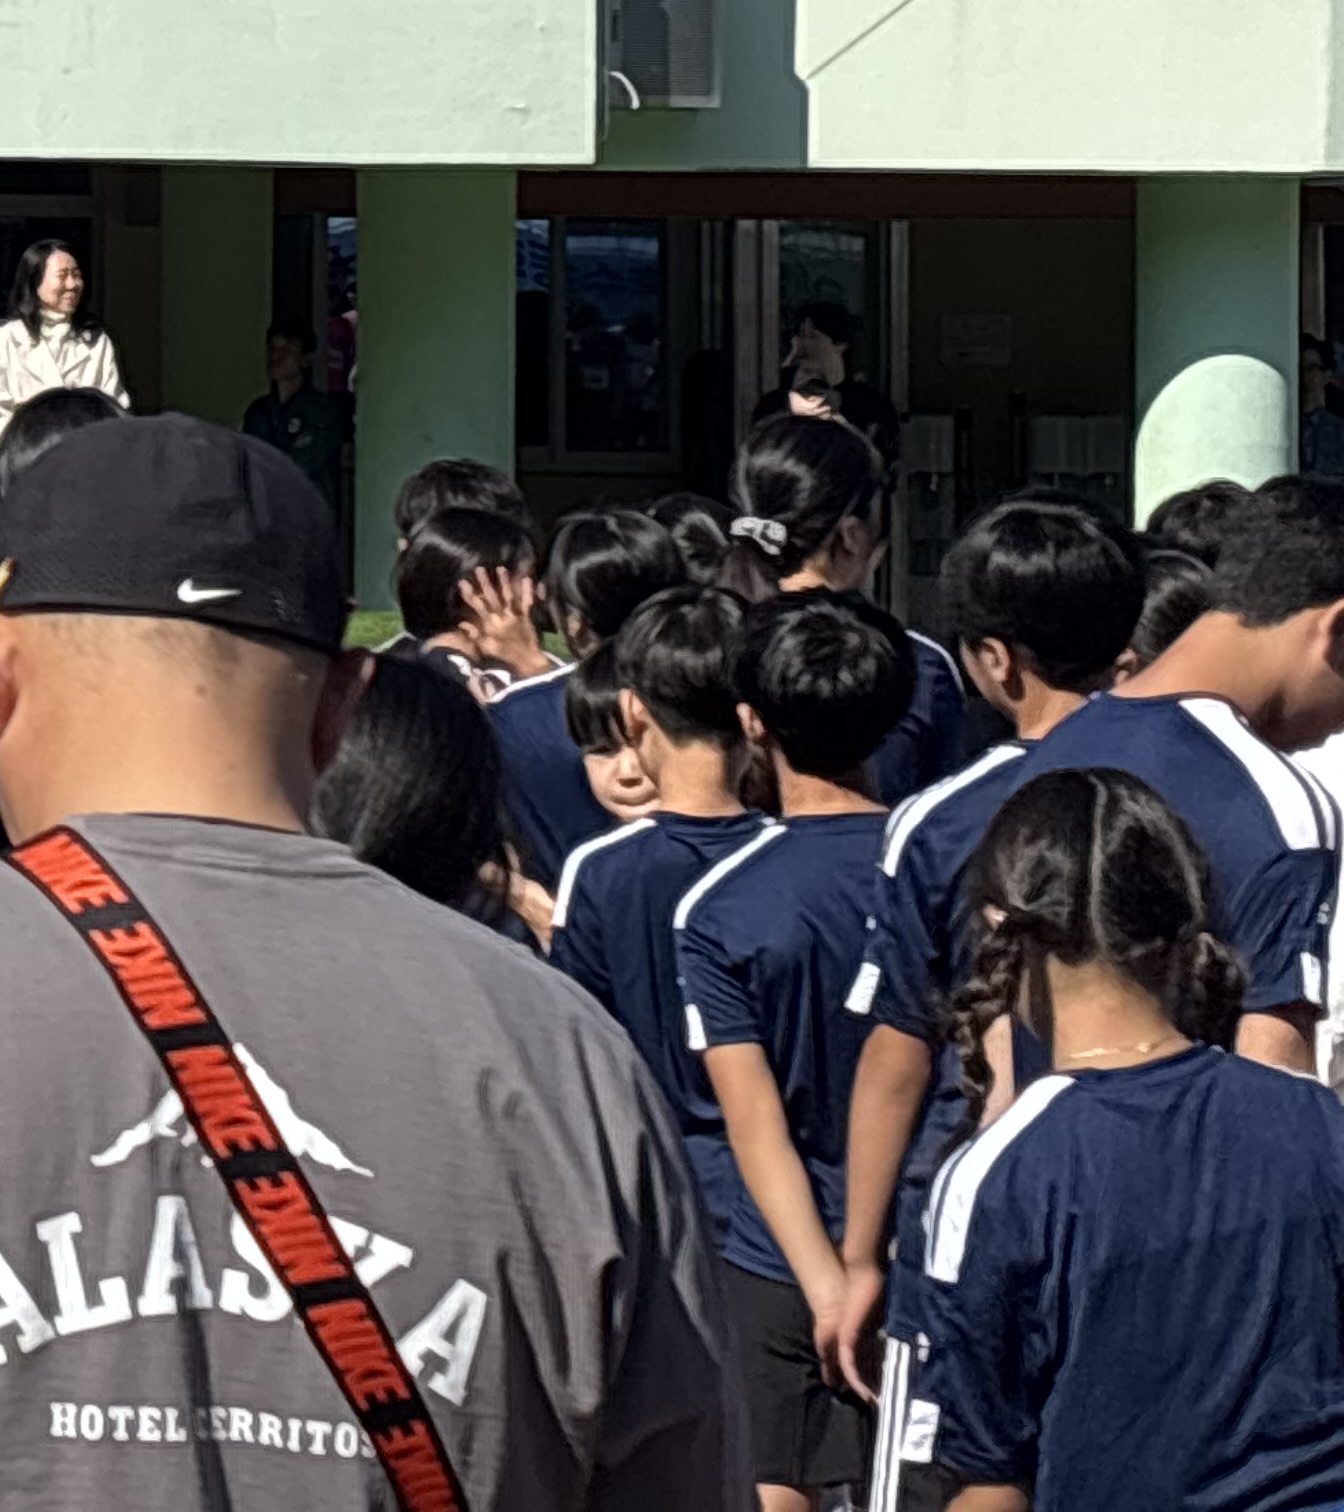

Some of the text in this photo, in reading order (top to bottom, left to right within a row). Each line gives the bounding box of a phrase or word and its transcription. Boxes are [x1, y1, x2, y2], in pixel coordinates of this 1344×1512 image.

[10, 833, 130, 916] NIKE
[88, 920, 209, 1030] NIKE
[165, 1044, 280, 1158] NIKE
[233, 1169, 349, 1285] NIKE
[306, 1296, 413, 1410] NIKE
[49, 1401, 188, 1443] HOTEL
